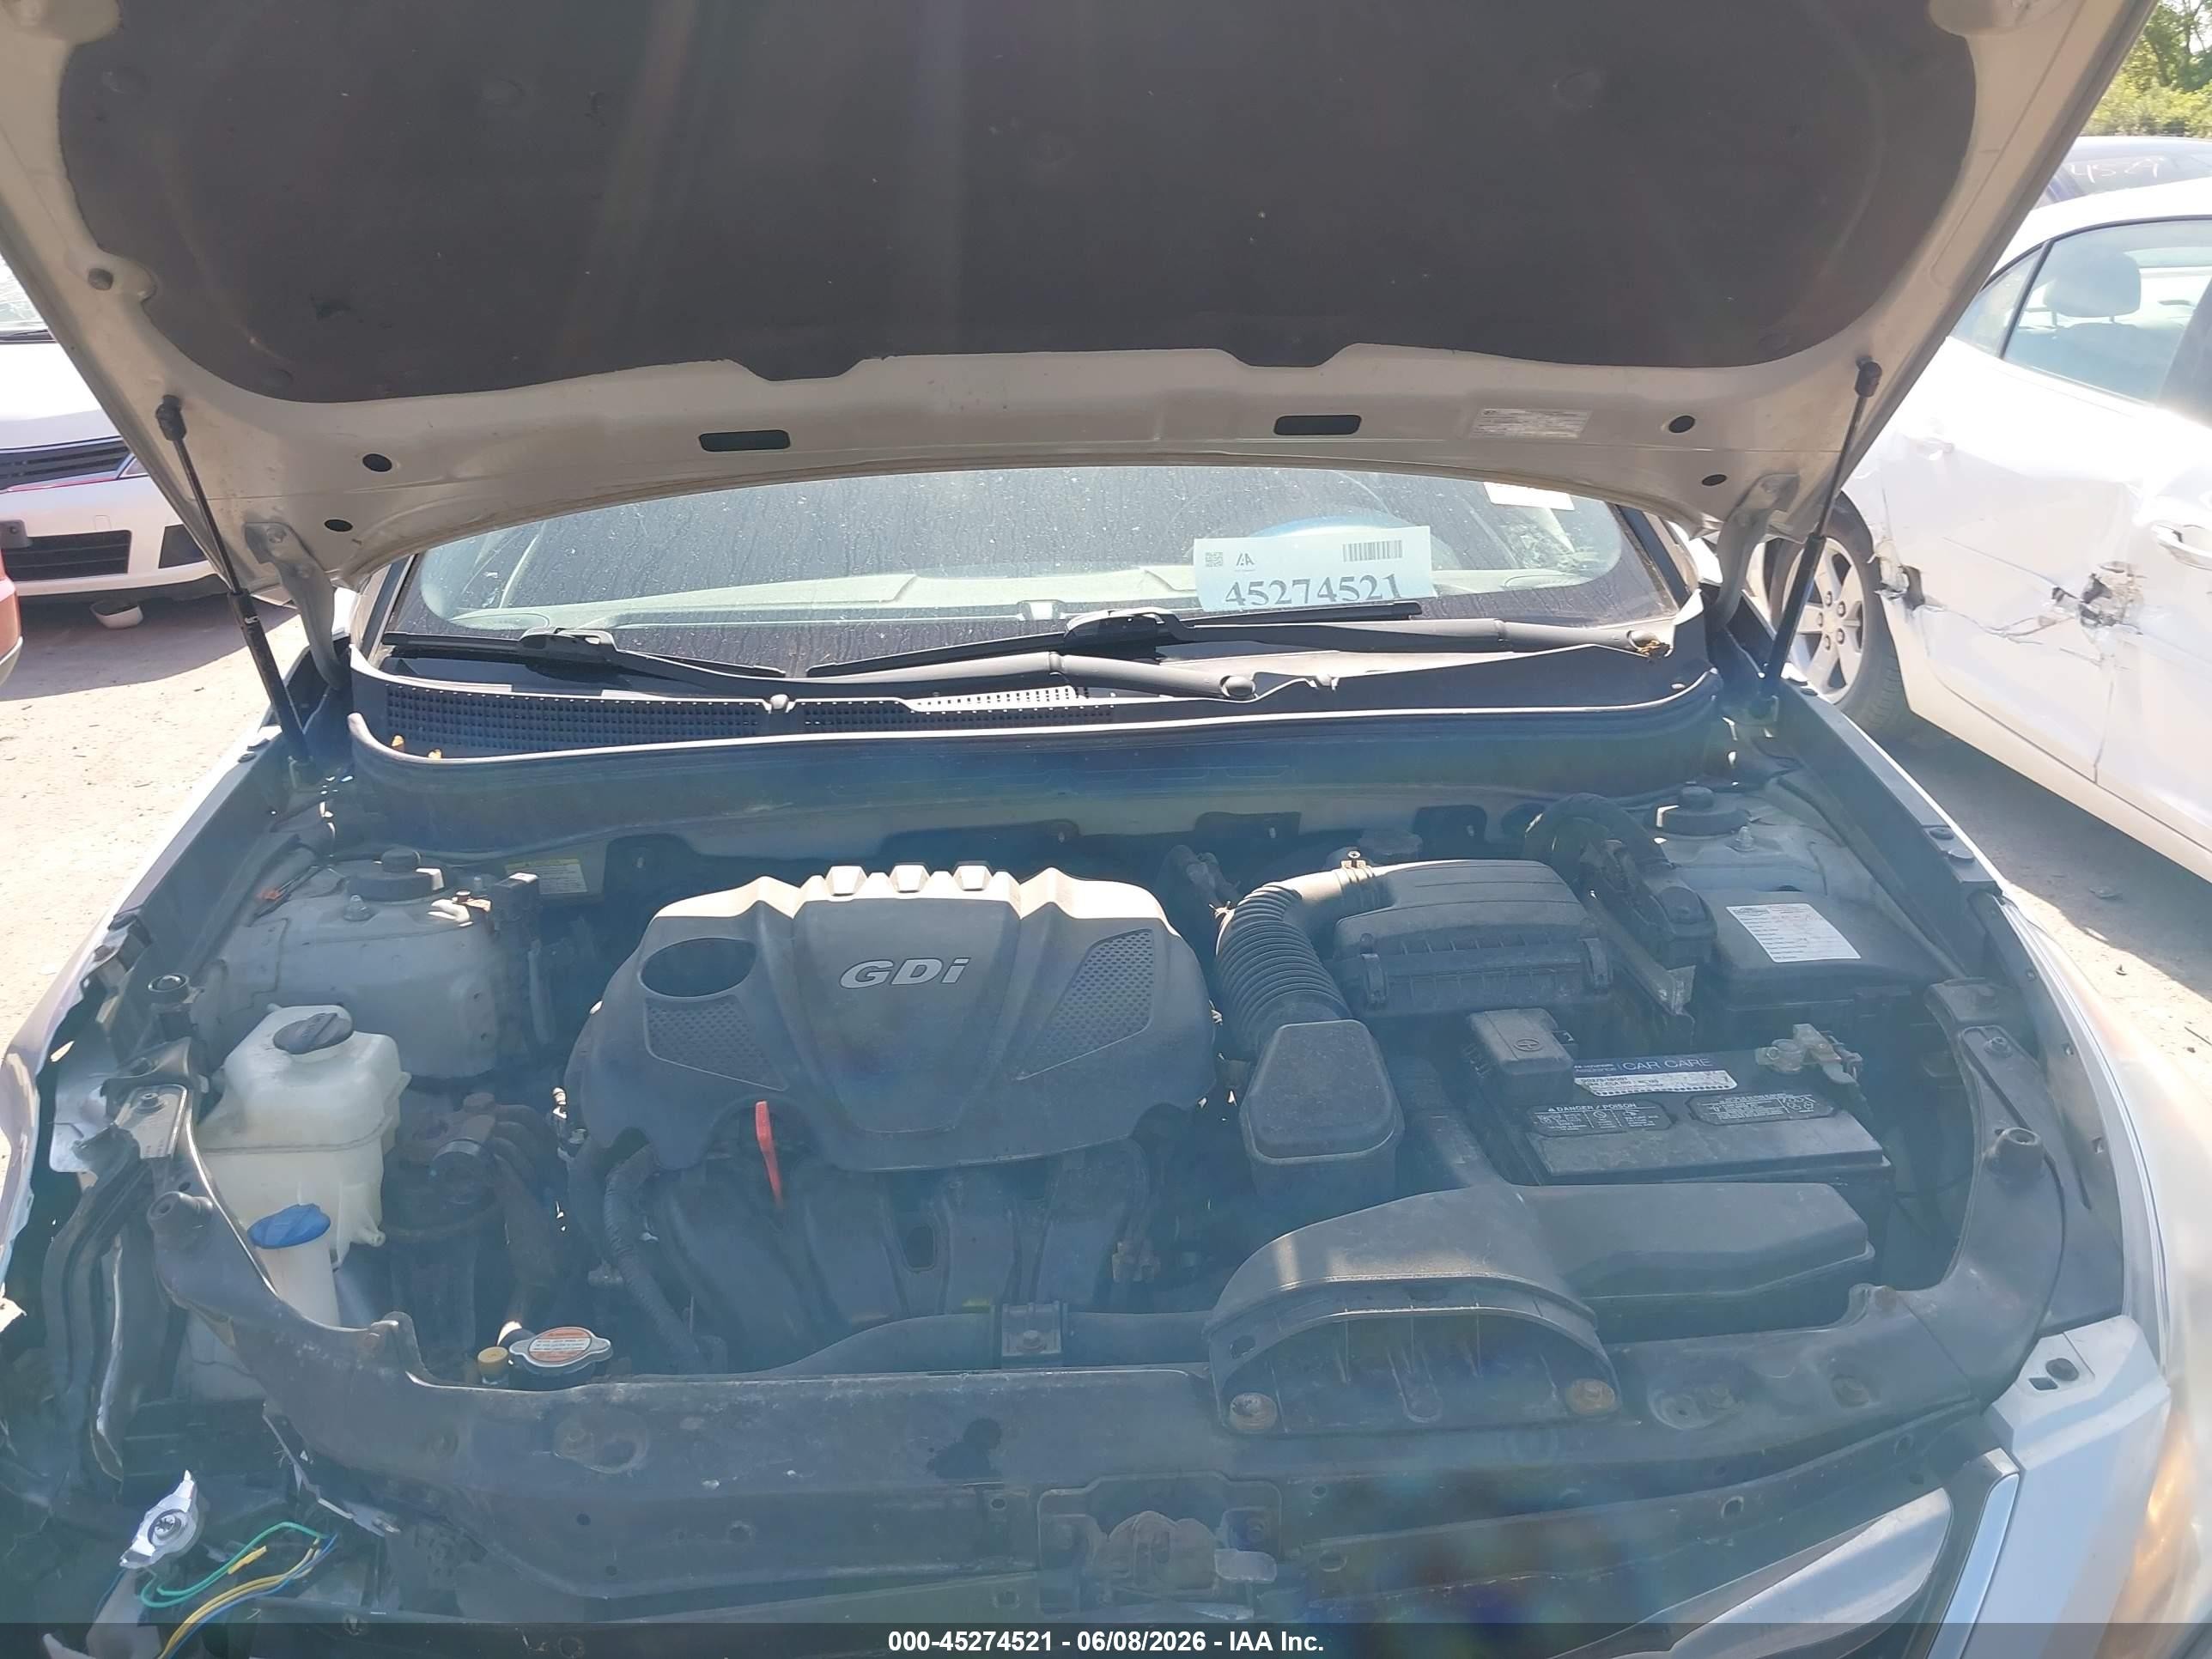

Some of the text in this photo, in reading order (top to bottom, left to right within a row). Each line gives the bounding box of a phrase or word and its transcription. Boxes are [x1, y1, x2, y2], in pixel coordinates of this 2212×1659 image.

[1225, 573, 1402, 606] 45274521
[840, 957, 972, 988] GDi
[1622, 1057, 1714, 1071] CAR CARE
[1556, 1104, 1595, 1113] DANGER
